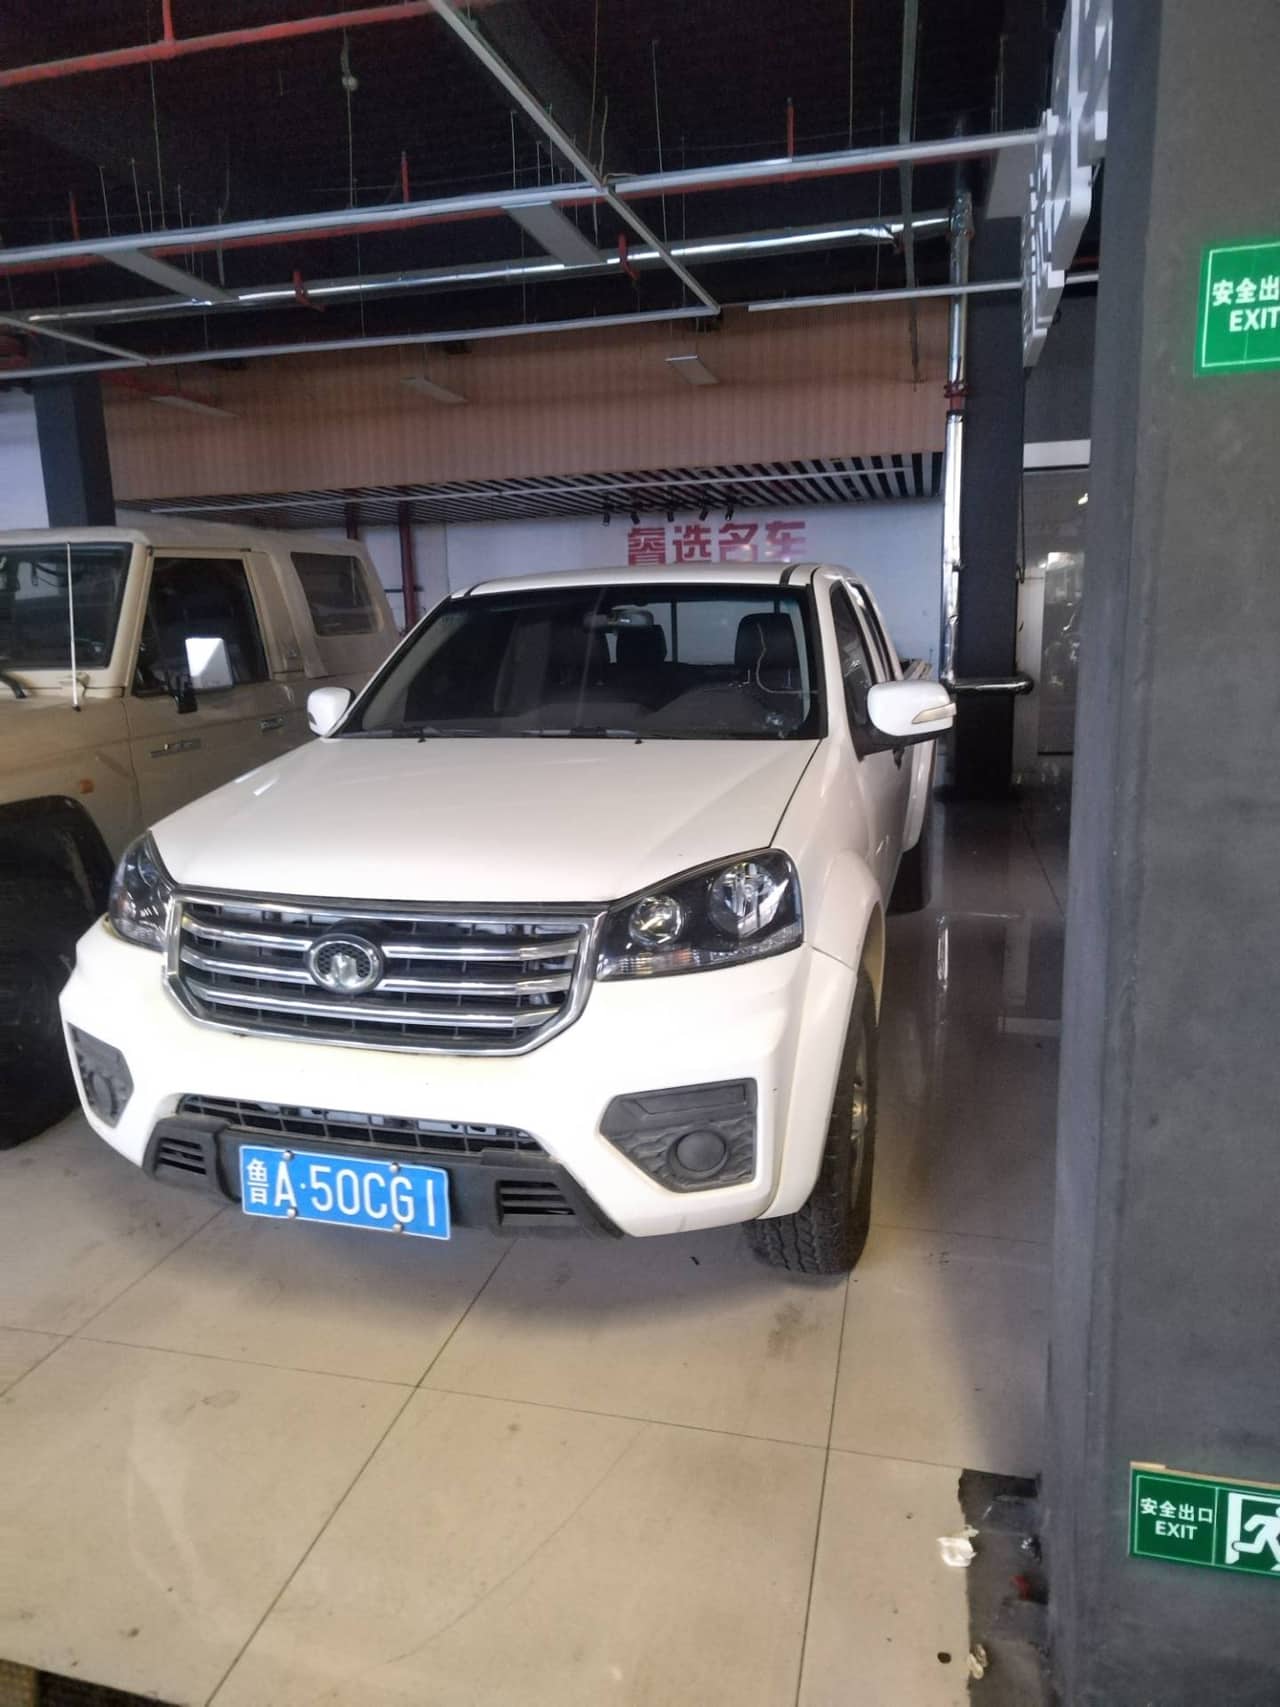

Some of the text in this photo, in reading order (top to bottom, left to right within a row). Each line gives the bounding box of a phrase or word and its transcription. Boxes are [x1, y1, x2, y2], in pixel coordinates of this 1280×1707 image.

[1212, 275, 1280, 306] 安全出
[1229, 305, 1280, 332] EXIT
[627, 520, 806, 566] 睿选名车
[1140, 1497, 1213, 1524] 安全出口
[1155, 1520, 1198, 1540] EXIT
